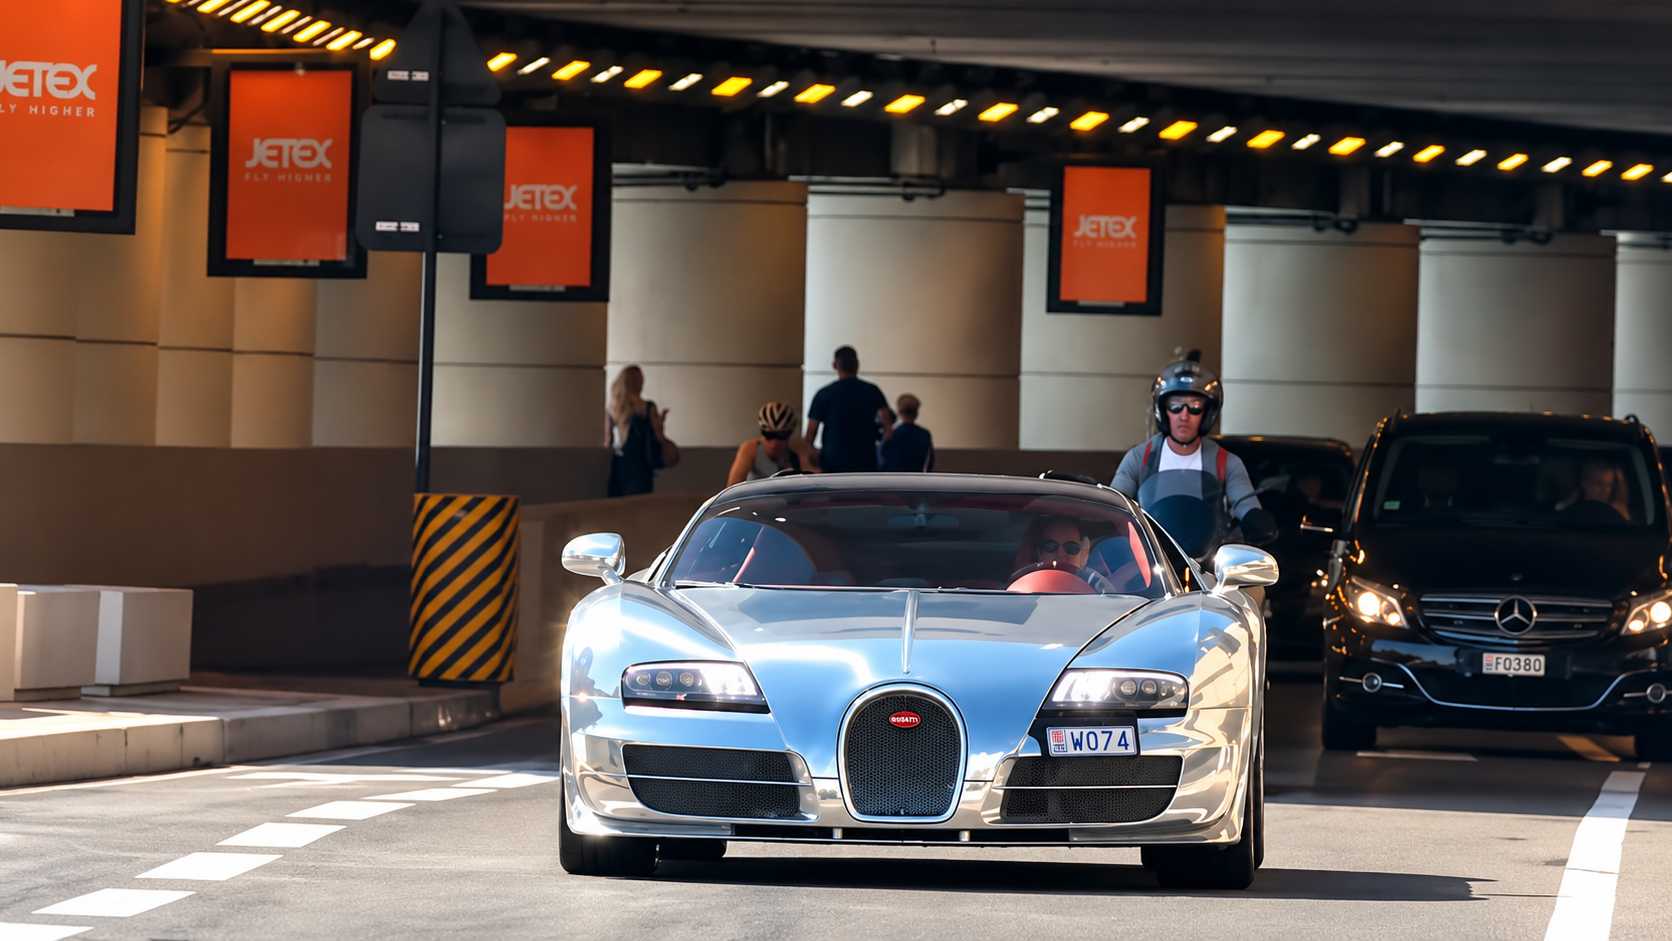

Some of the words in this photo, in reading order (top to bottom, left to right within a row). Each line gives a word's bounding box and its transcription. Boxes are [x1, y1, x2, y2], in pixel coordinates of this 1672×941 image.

[0, 104, 16, 113] LY
[29, 105, 95, 117] HIGHER
[245, 138, 333, 169] JETEX
[245, 172, 269, 181] FLY
[278, 174, 332, 182] HIGHER
[504, 184, 578, 211] JETEX
[1073, 214, 1138, 239] JETEX
[1495, 656, 1542, 673] F0380
[1070, 730, 1129, 751] W074
